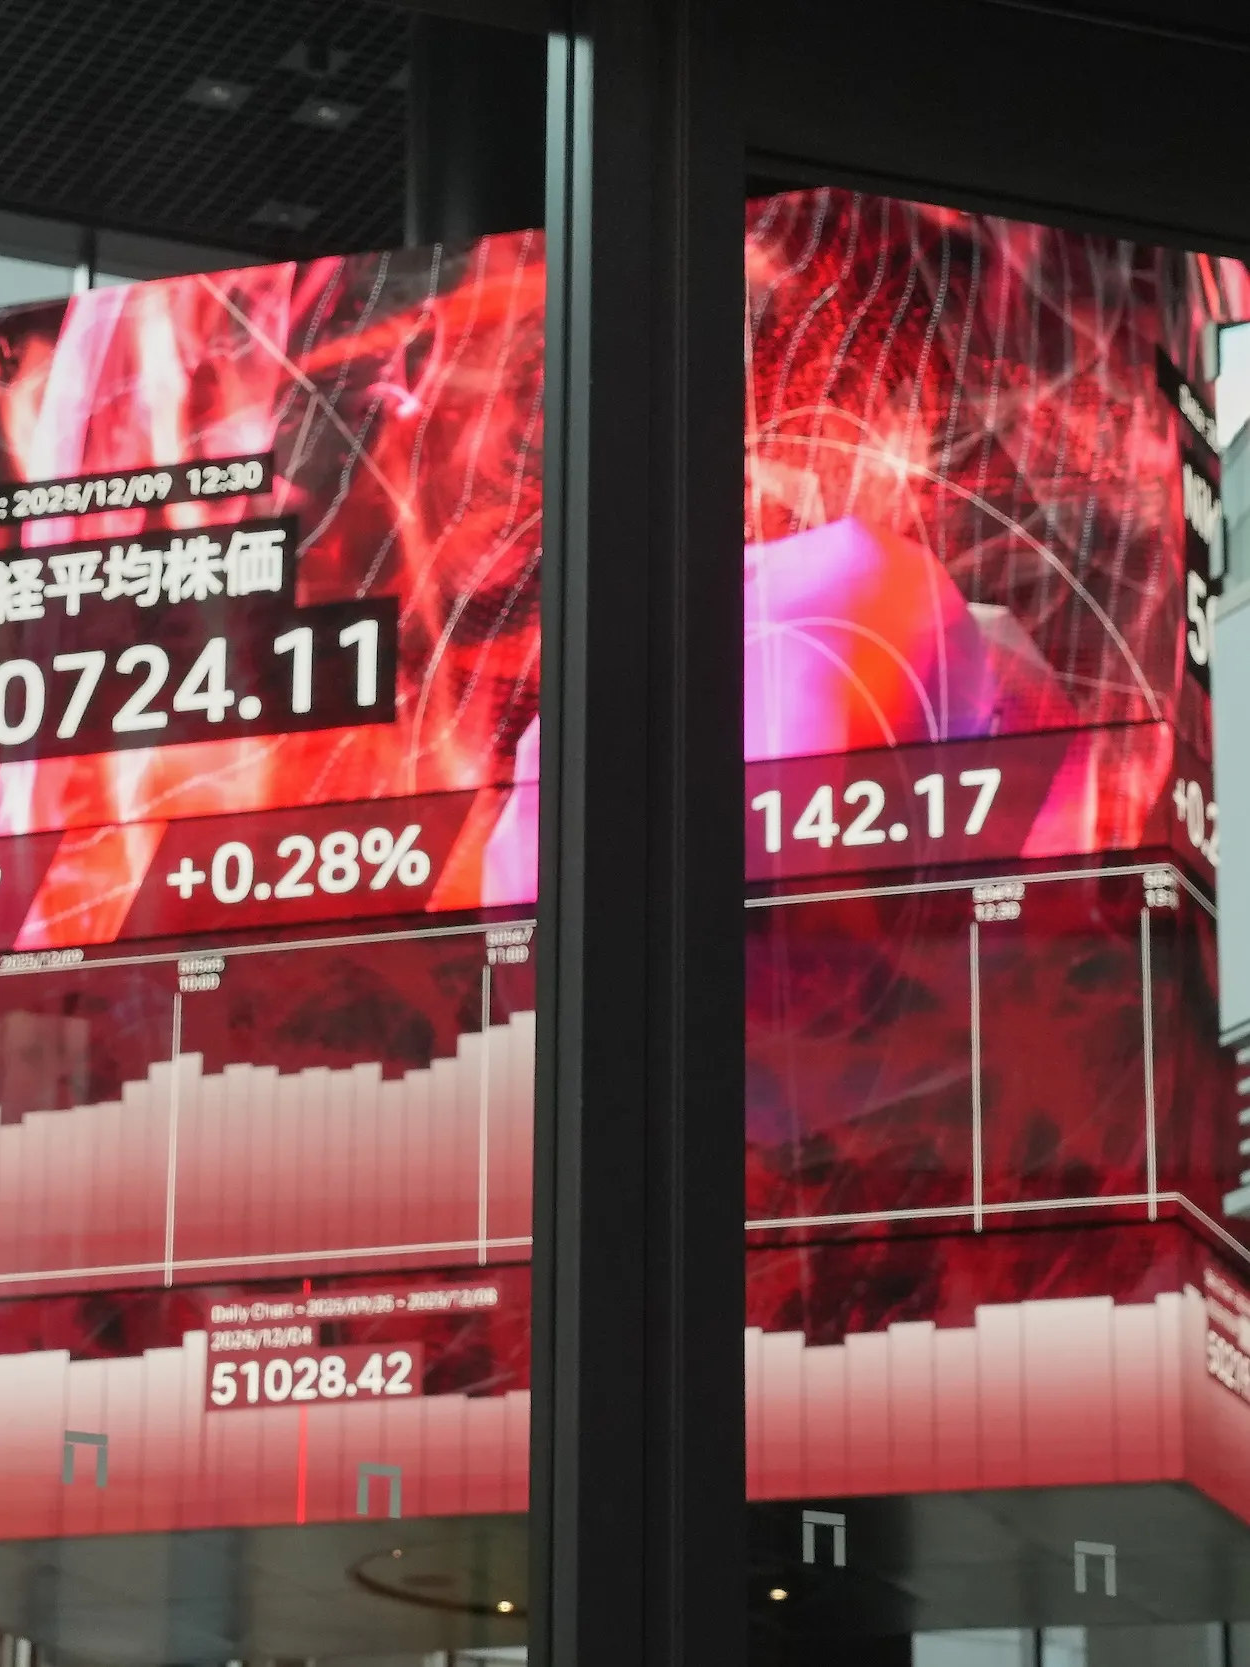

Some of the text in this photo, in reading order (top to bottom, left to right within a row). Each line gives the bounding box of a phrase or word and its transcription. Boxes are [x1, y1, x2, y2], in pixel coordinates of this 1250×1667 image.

[12, 472, 172, 518] 2025/12/09
[186, 461, 263, 495] 12:30
[752, 768, 1001, 852] 142.17
[166, 825, 431, 904] +0.28%
[211, 1351, 412, 1405] 51028.42
